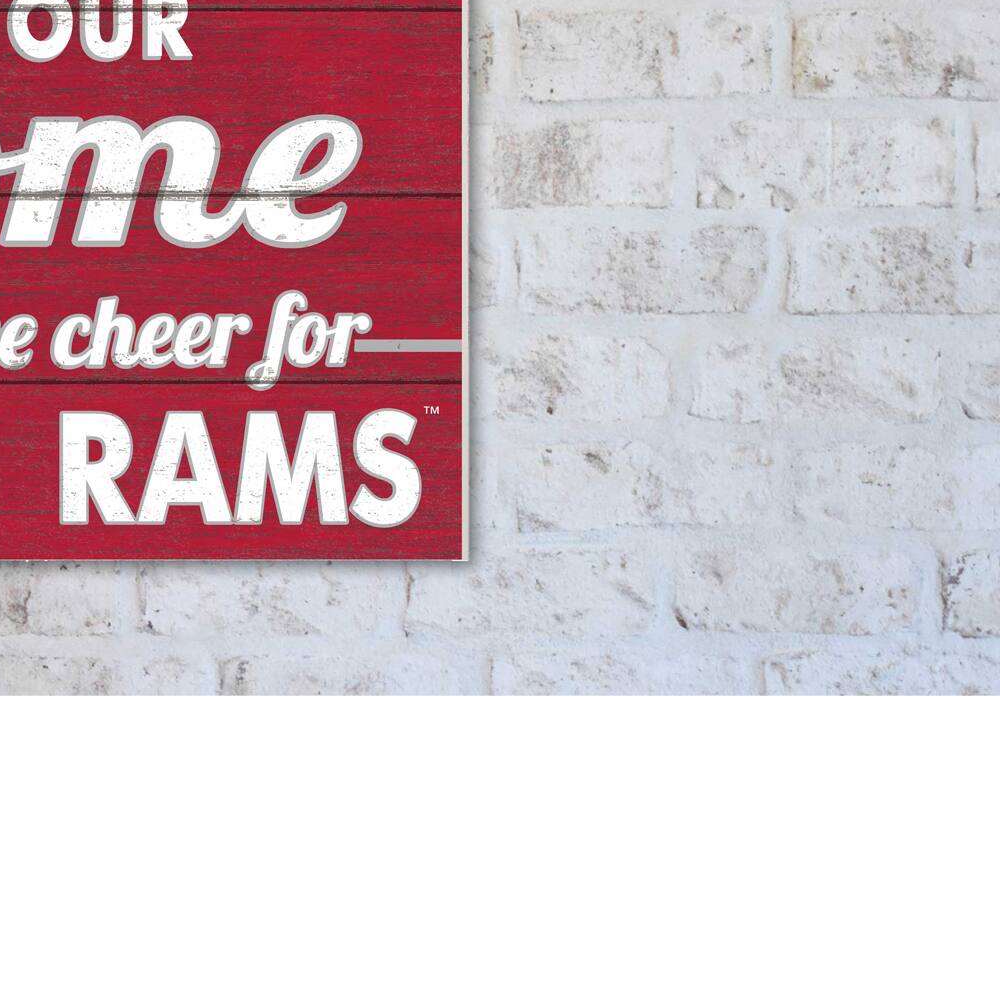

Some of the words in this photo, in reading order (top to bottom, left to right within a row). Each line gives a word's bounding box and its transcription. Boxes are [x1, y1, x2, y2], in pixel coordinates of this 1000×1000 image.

[50, 296, 253, 369] cheer
[245, 290, 372, 391] for
[59, 409, 422, 527] RAMS
